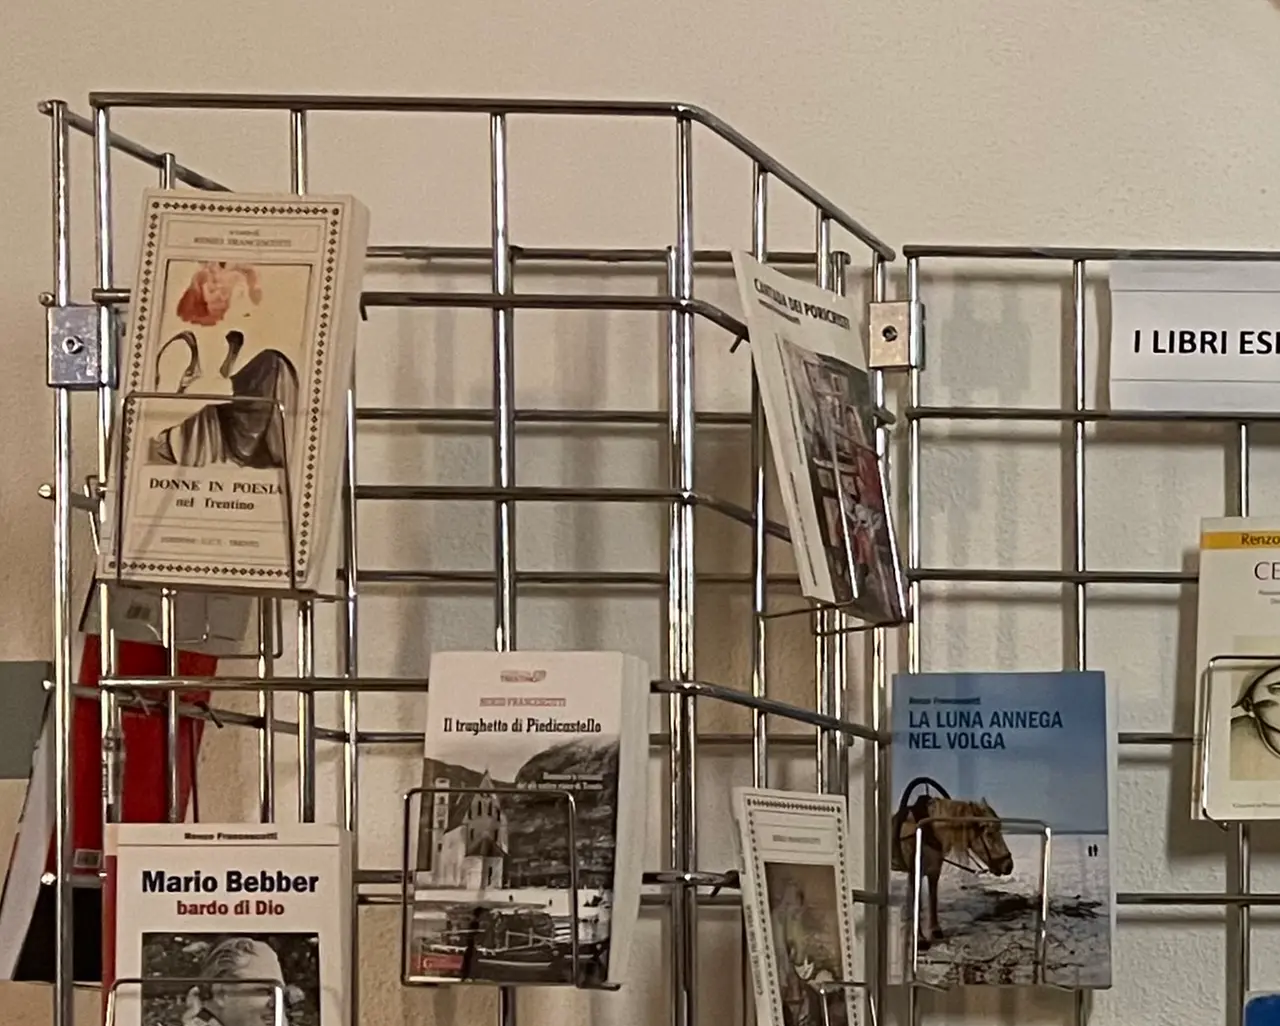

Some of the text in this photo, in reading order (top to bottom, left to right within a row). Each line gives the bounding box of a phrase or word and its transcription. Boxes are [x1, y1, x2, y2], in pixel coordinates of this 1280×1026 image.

[1133, 330, 1141, 353] I
[1151, 330, 1228, 355] LIBRI
[150, 478, 283, 494] DONNE IN POESIA
[176, 498, 254, 510] nel Trentino
[1241, 532, 1280, 545] Renzo
[443, 717, 602, 736] Il traghetto di Piedicastello
[909, 710, 1063, 729] LA LUNA ANNEGA
[909, 732, 1006, 750] NEL VOLGA
[142, 870, 319, 893] Mario Bebber
[177, 900, 285, 915] bardo di Dio
